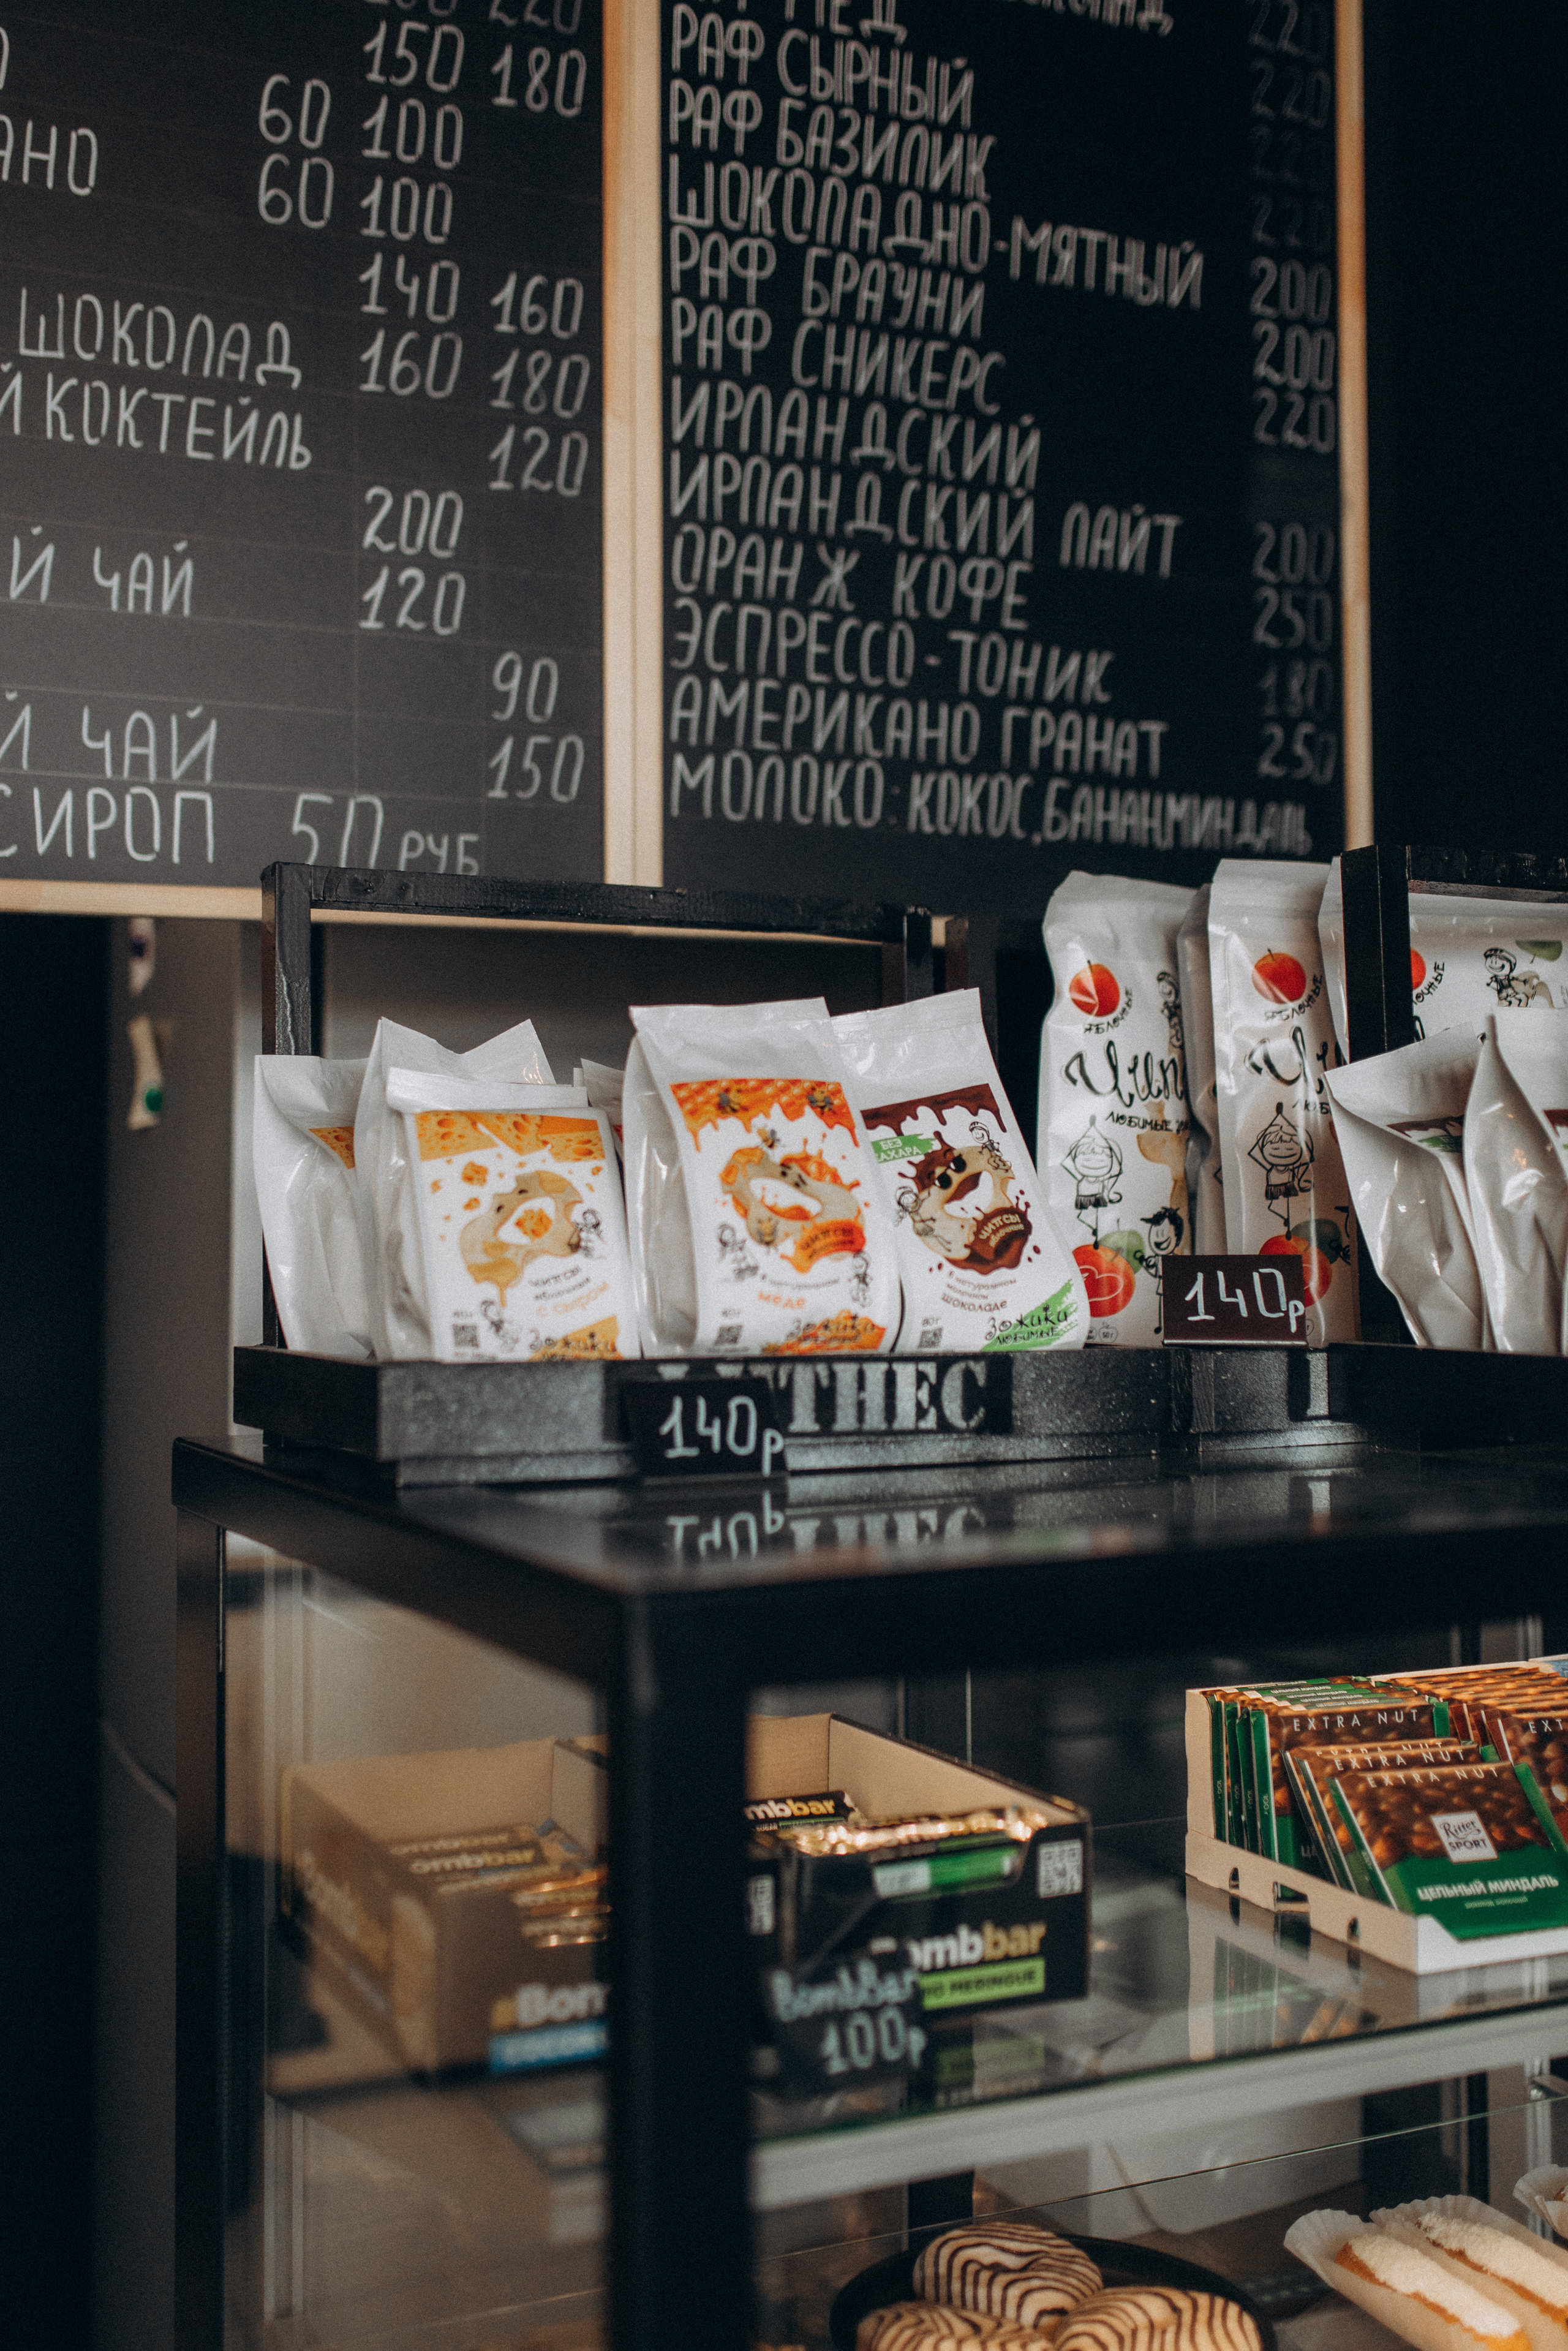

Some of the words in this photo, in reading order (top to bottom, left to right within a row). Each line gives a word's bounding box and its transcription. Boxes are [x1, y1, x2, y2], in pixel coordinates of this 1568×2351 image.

[363, 20, 465, 92] 150
[492, 44, 586, 116] 180
[672, 3, 765, 85] РАФ
[777, 28, 974, 130] СЫРНЫЙ
[258, 74, 331, 149] 60
[363, 96, 463, 169] 100
[669, 79, 763, 156] РАФ
[777, 97, 997, 202] БАЗИЛИК
[258, 153, 334, 228] 60
[360, 176, 453, 244] 100
[360, 252, 459, 323] 140
[491, 271, 584, 339] 160
[669, 225, 777, 306] РАФ
[802, 246, 984, 339] БРАУНИ
[1250, 256, 1332, 325] 200
[19, 287, 301, 389] ШОКОЛАД
[360, 328, 462, 398] 160
[491, 349, 589, 418] 180
[671, 296, 772, 376] РАФ
[793, 319, 1005, 415] СНИКЕРС
[1252, 320, 1336, 392] 200
[47, 371, 312, 470] КОКТЕЙЛЬ
[491, 425, 588, 496] 120
[671, 375, 1040, 489] ИРЛАНДСКИЙ
[1253, 387, 1336, 455] 220
[363, 486, 464, 557] 200
[671, 450, 1035, 560] ИРЛАНДСКИЙ
[1060, 502, 1183, 578] ЛАЙТ
[1253, 521, 1335, 586] 200
[93, 540, 194, 617] ЧАЙ
[360, 567, 466, 635] 120
[892, 551, 1032, 630] КОФЕ
[1253, 586, 1333, 652] 250
[492, 652, 559, 723] 90
[671, 674, 980, 764] АМЕРИКАНО
[1002, 706, 1169, 779] ГРАНАТ
[1257, 722, 1337, 784] 250
[82, 706, 217, 783] ЧАЙ
[488, 735, 584, 802] 150
[292, 793, 384, 869] 50
[1294, 1714, 1360, 1731] EXTRA
[1378, 1709, 1417, 1724] NUT
[1335, 1754, 1406, 1771] EXTRA
[1421, 1749, 1464, 1764] NUT
[1366, 1771, 1441, 1787] EXTRA
[1454, 1767, 1498, 1781] NUT
[1441, 1821, 1481, 1840] Ritter
[1448, 1839, 1487, 1852] SPORT
[1417, 1879, 1487, 1901] ЦЕЛЬНЫЙ
[1487, 1874, 1559, 1893] МИНДАЛЬ
